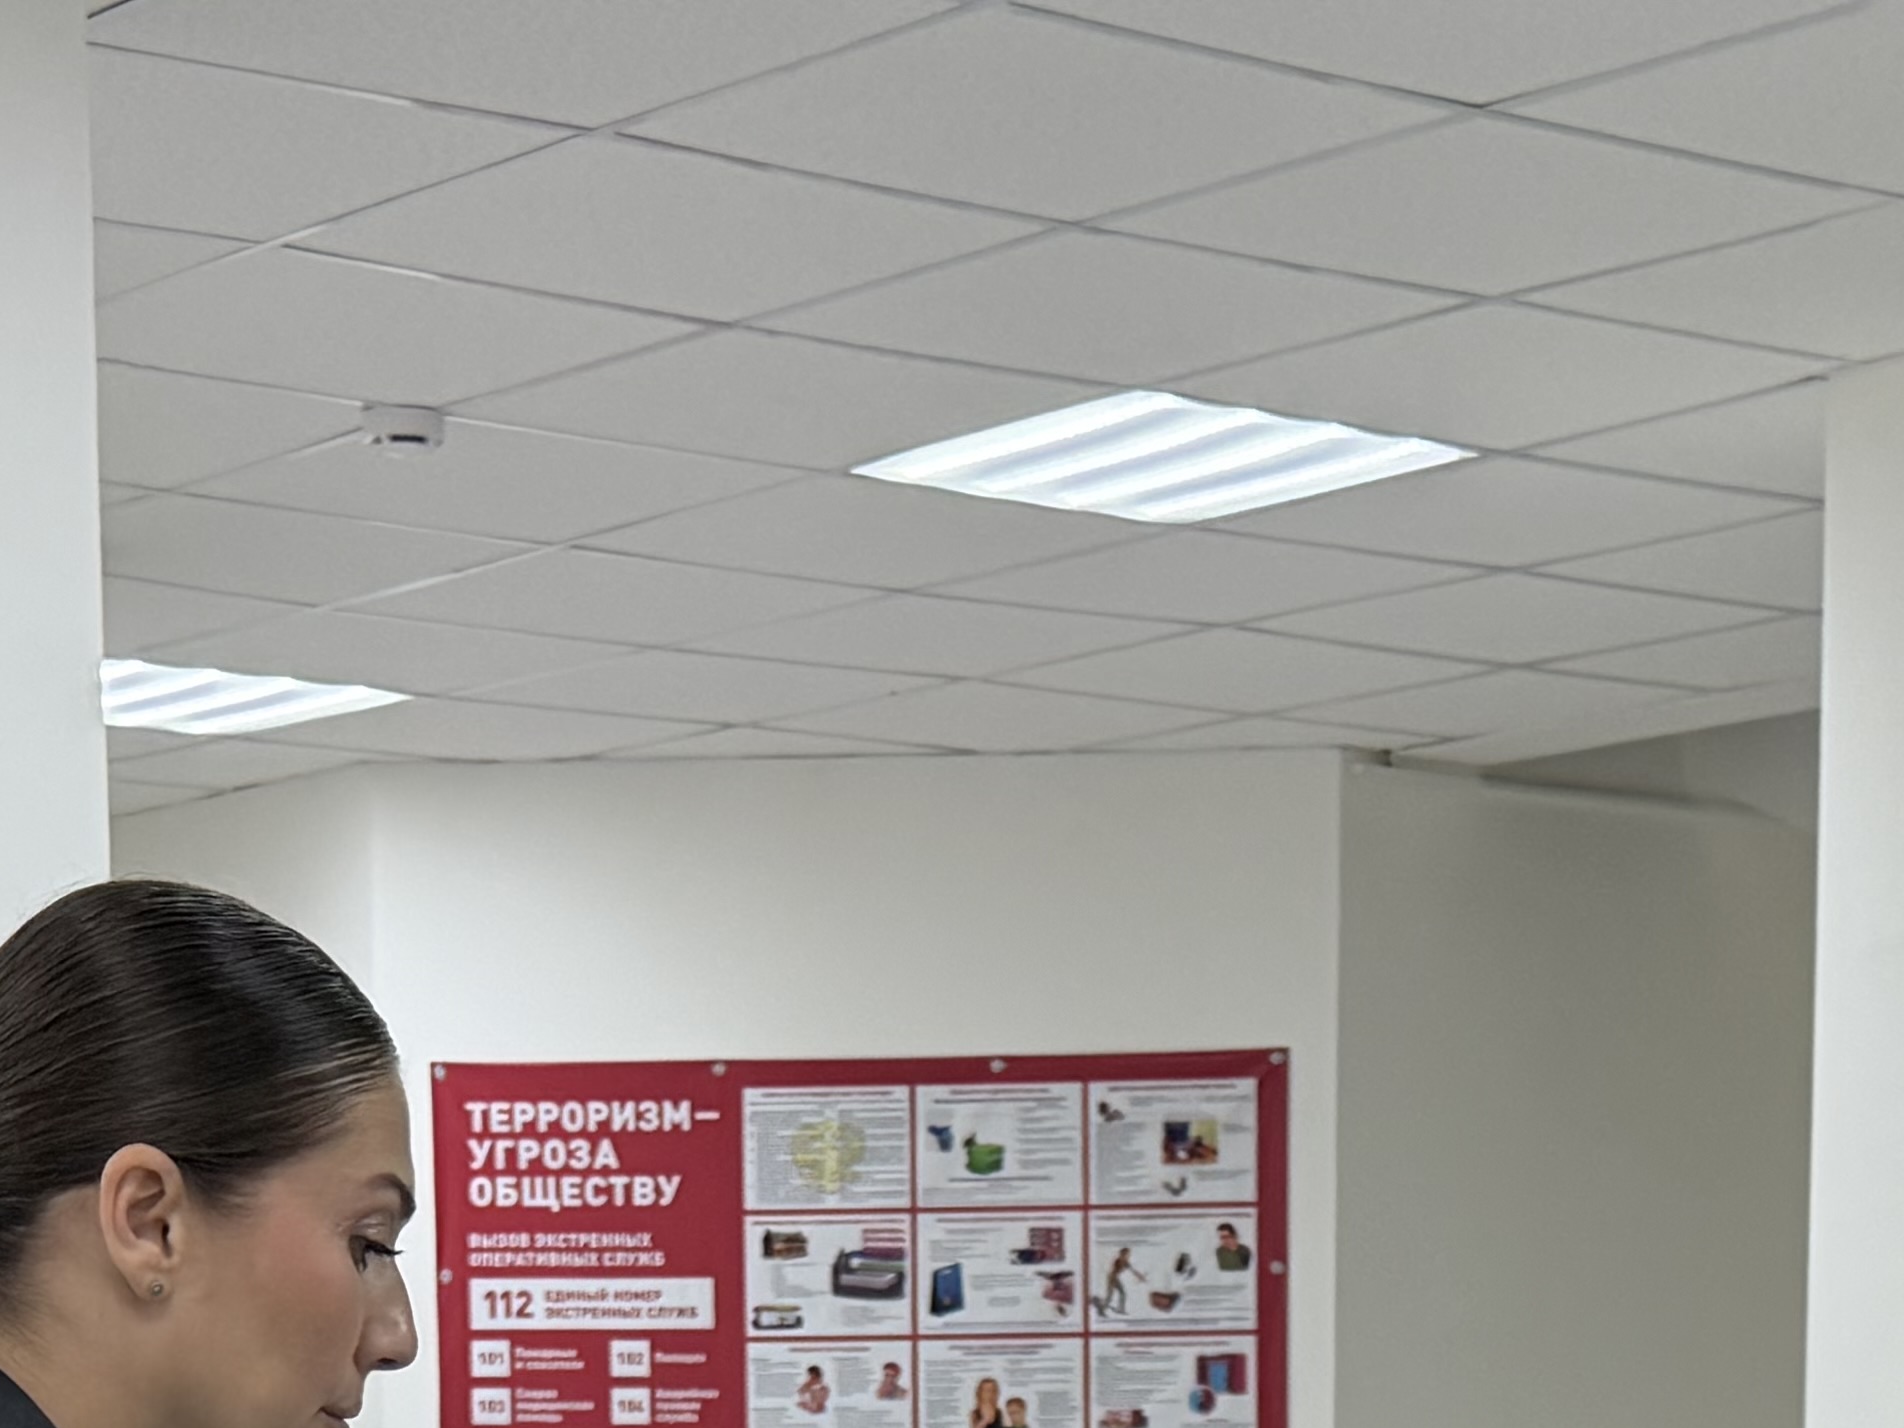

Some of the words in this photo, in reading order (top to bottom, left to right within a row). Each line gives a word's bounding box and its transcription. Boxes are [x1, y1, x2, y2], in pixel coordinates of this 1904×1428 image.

[466, 1138, 621, 1170] УГРОЗА
[468, 1174, 683, 1212] ОБЩЕСТВУ
[467, 1232, 531, 1248] ВЫЗОВ
[534, 1232, 653, 1248] ЭКСТРЕННЫХ
[467, 1251, 600, 1267] ОПЕРАТИВНЫХ
[602, 1251, 666, 1267] СЛУЖБ
[484, 1289, 534, 1320] 112
[613, 1290, 663, 1303] НОМЕР
[545, 1306, 643, 1320] ЭКСТРЕННЫХ
[647, 1306, 699, 1320] СЛУЖБ
